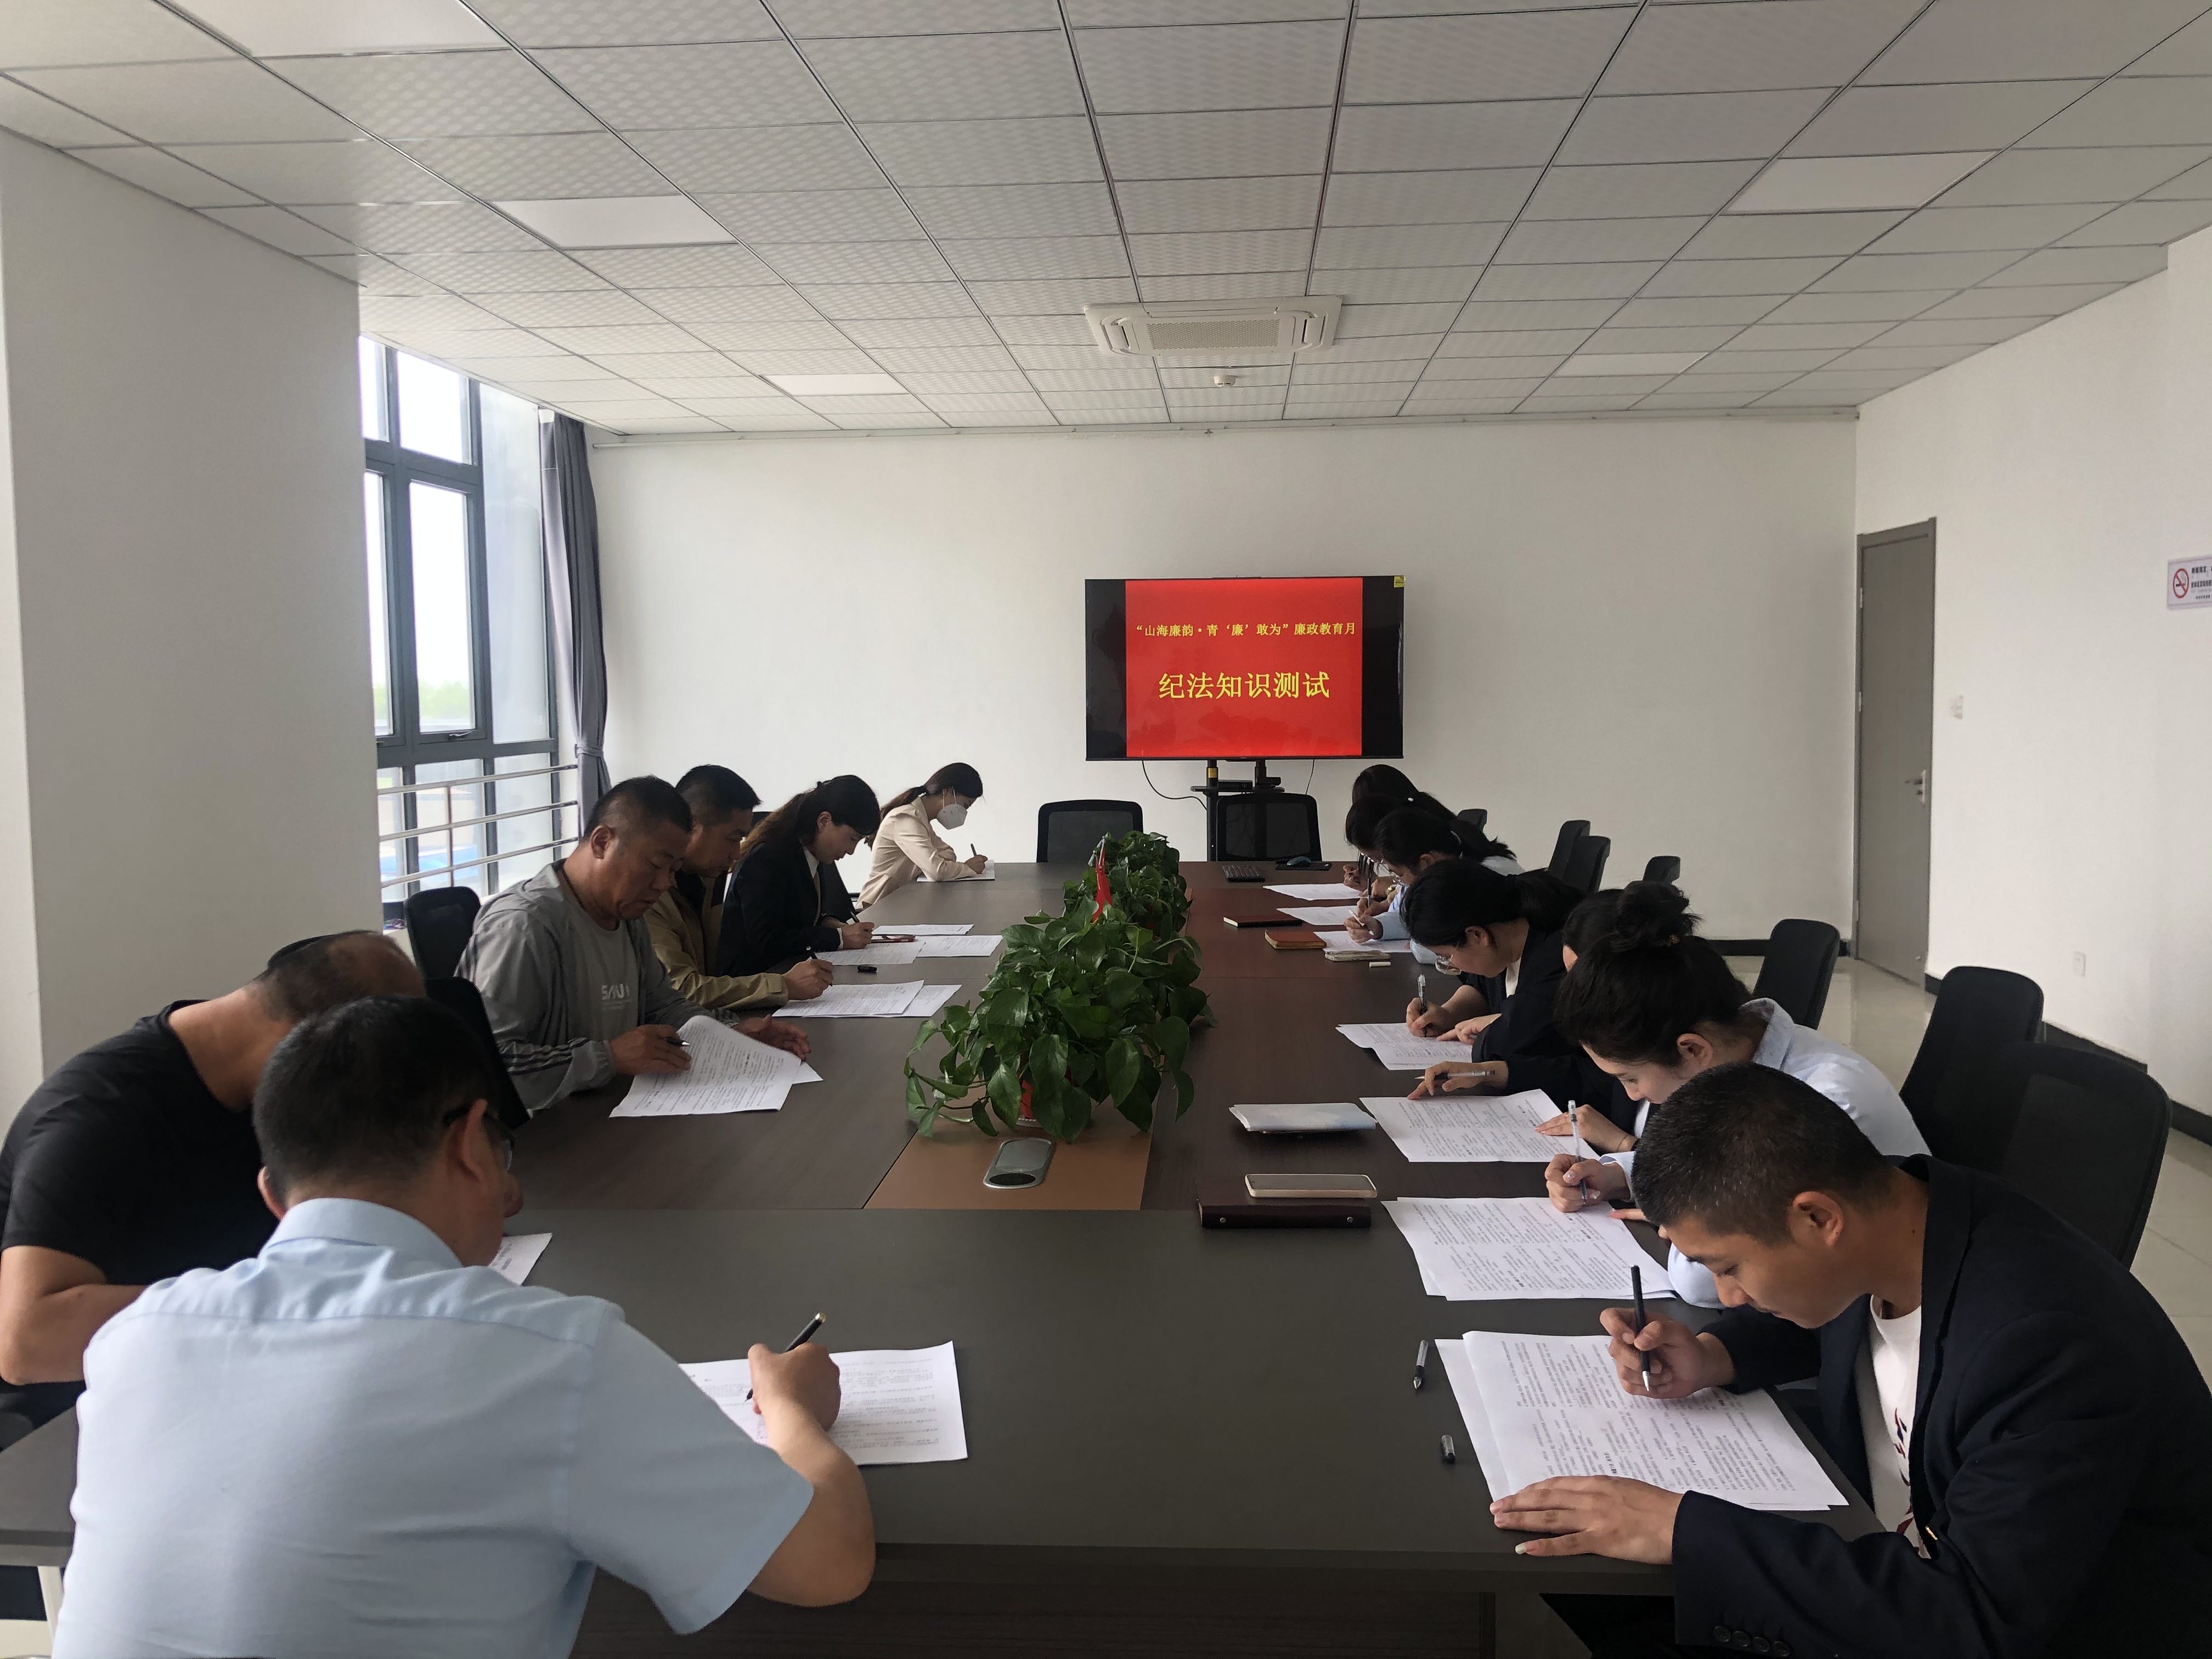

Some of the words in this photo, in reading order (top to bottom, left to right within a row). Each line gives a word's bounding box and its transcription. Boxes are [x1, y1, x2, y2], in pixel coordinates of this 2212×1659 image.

[1159, 671, 1330, 699] 纪法知识测试
